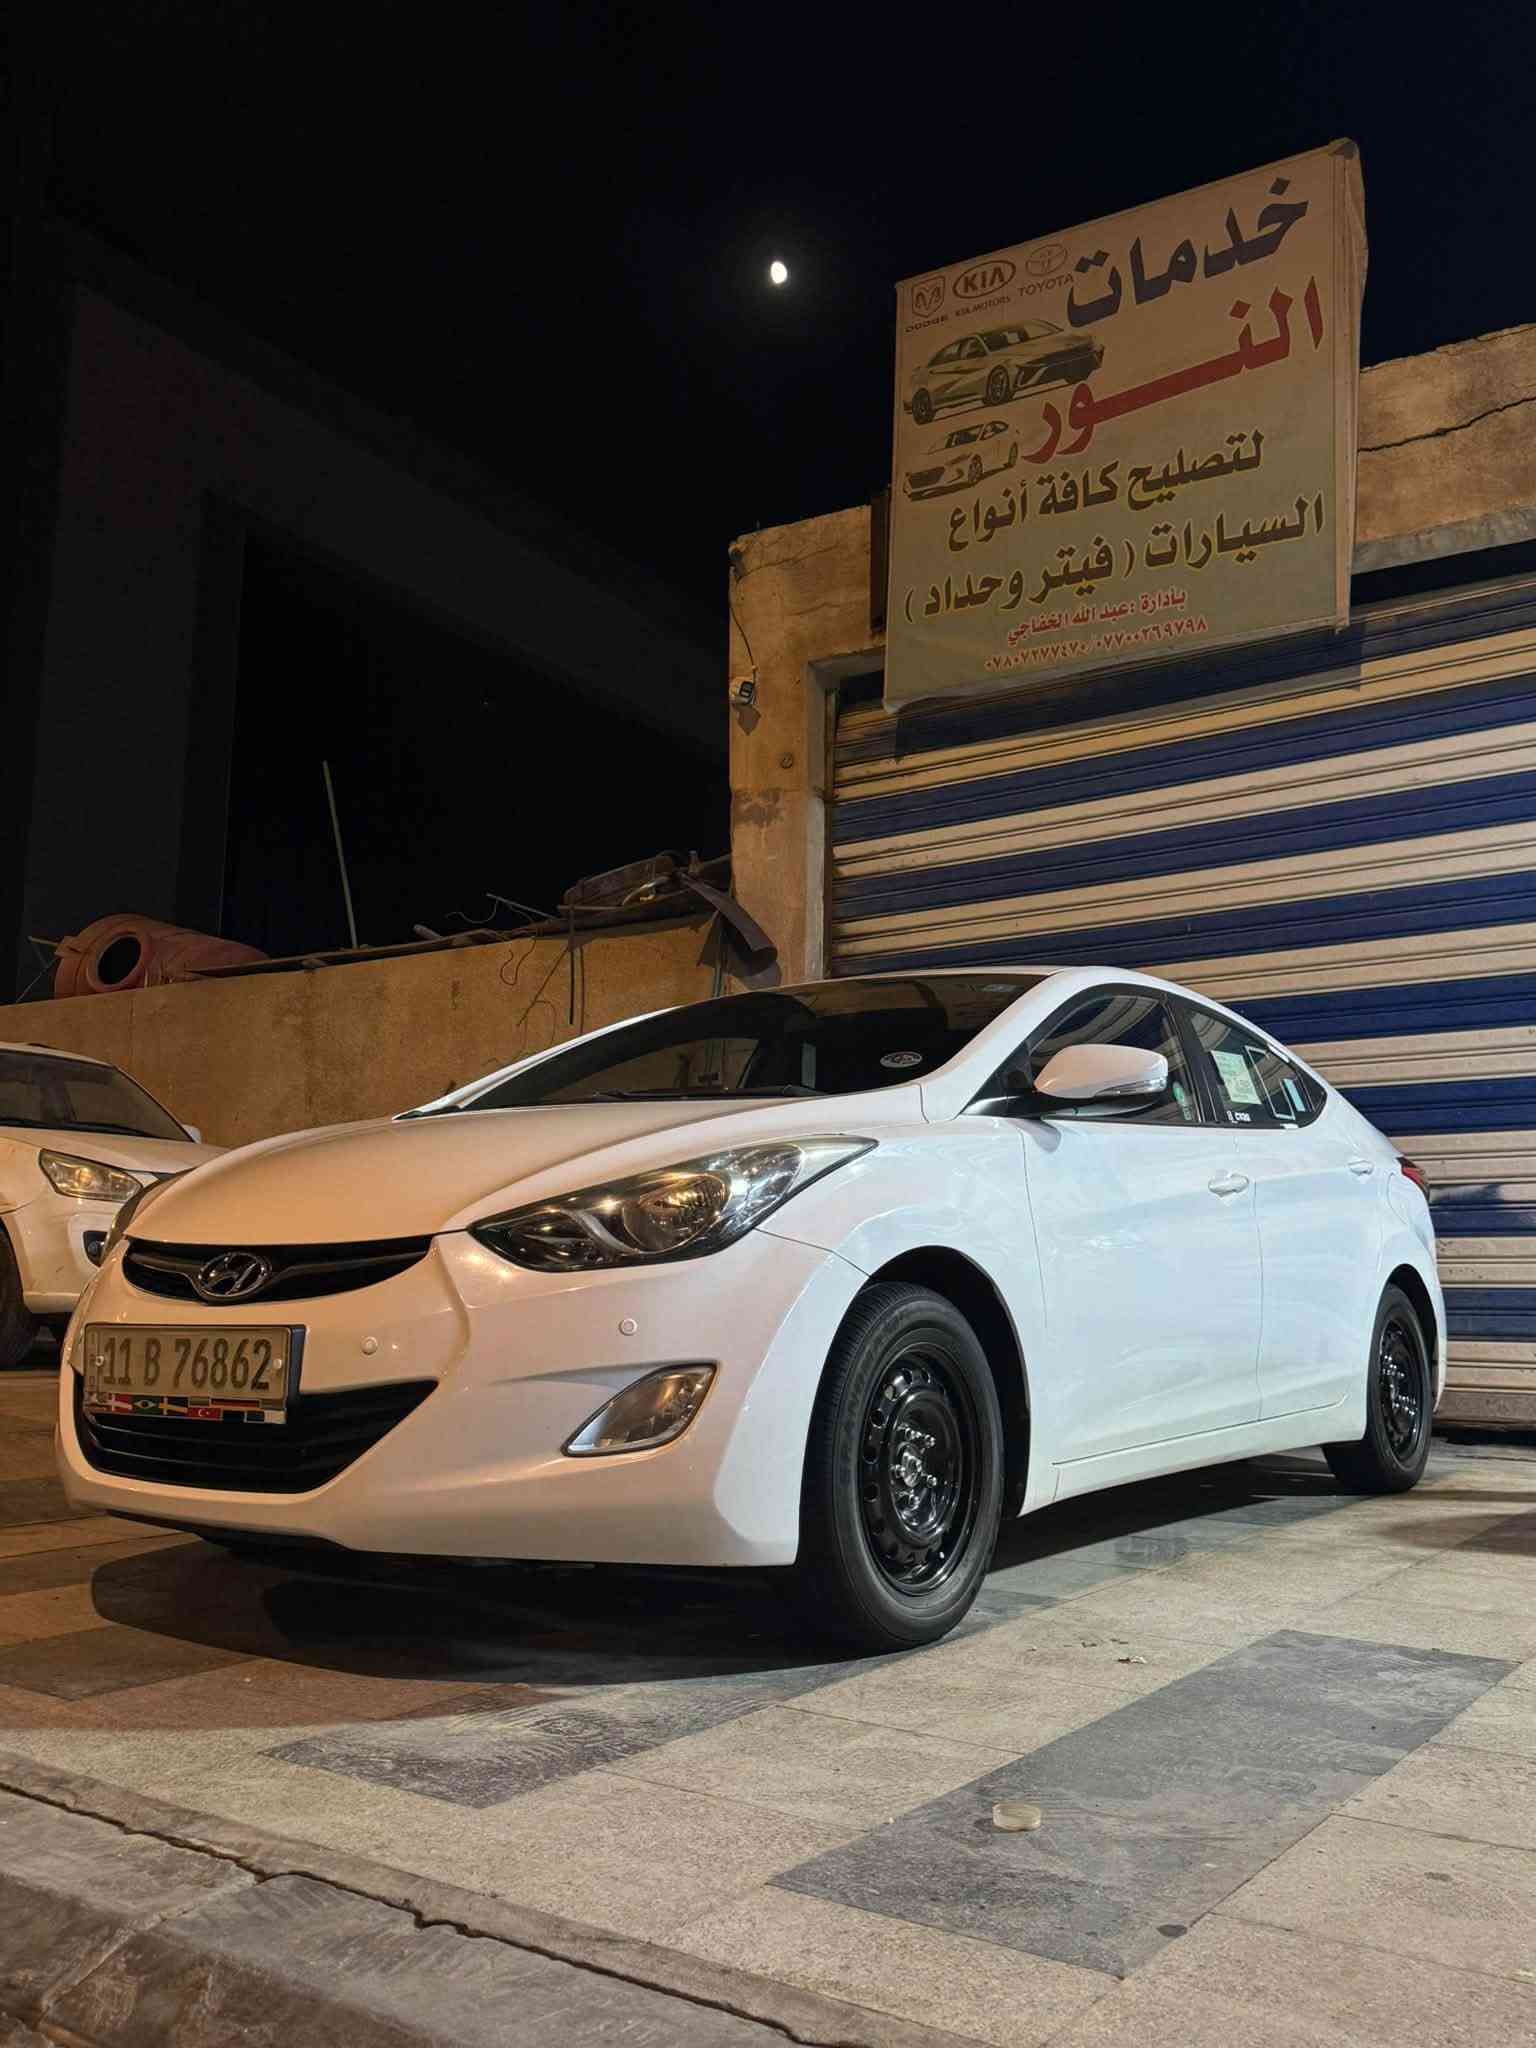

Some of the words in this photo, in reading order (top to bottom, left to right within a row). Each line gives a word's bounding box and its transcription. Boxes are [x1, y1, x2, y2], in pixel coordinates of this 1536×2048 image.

[963, 266, 1005, 294] KIA
[1018, 274, 1075, 297] TOYOTA
[1066, 176, 1310, 329] خدمات
[1021, 274, 1325, 465] النور
[1038, 458, 1120, 518] كافة
[1127, 429, 1264, 511] لتصليح
[947, 480, 1029, 552] أنواع
[1144, 493, 1325, 569] السيارات
[103, 1336, 132, 1386] 11
[143, 1337, 161, 1386] B
[174, 1338, 273, 1391] 76862
